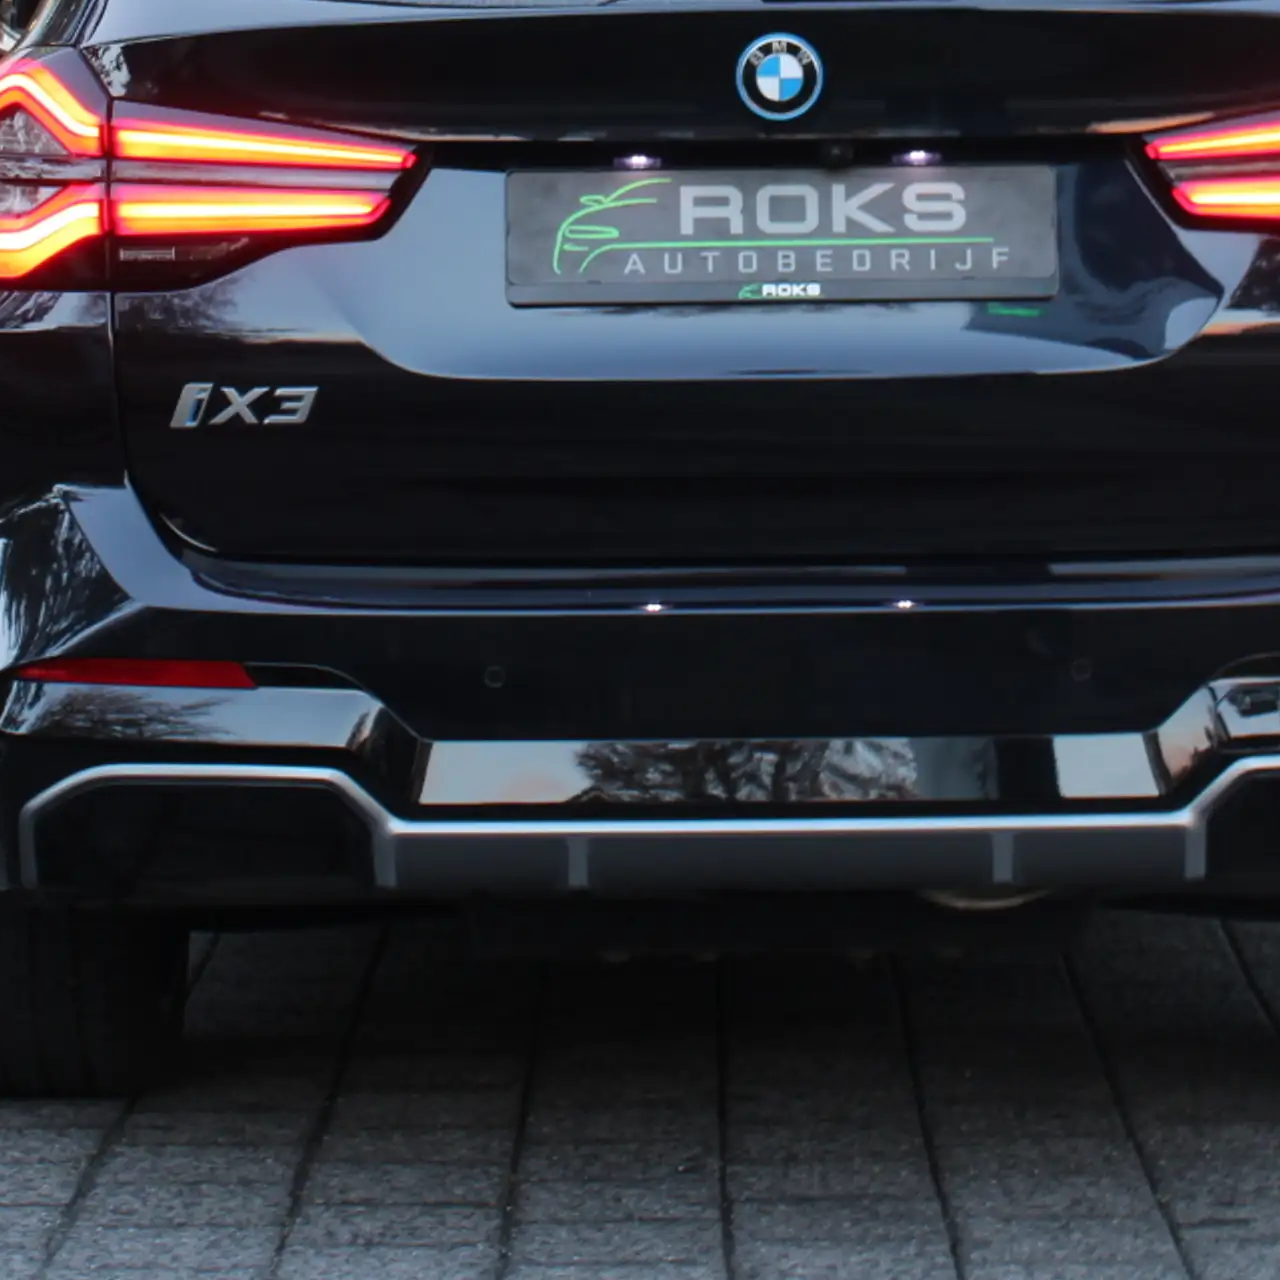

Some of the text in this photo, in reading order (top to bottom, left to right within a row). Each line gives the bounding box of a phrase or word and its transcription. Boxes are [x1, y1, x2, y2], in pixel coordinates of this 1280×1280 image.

[679, 182, 967, 235] ROKS
[624, 247, 1010, 275] AUTOBEDRIJF
[762, 283, 821, 297] ROKS
